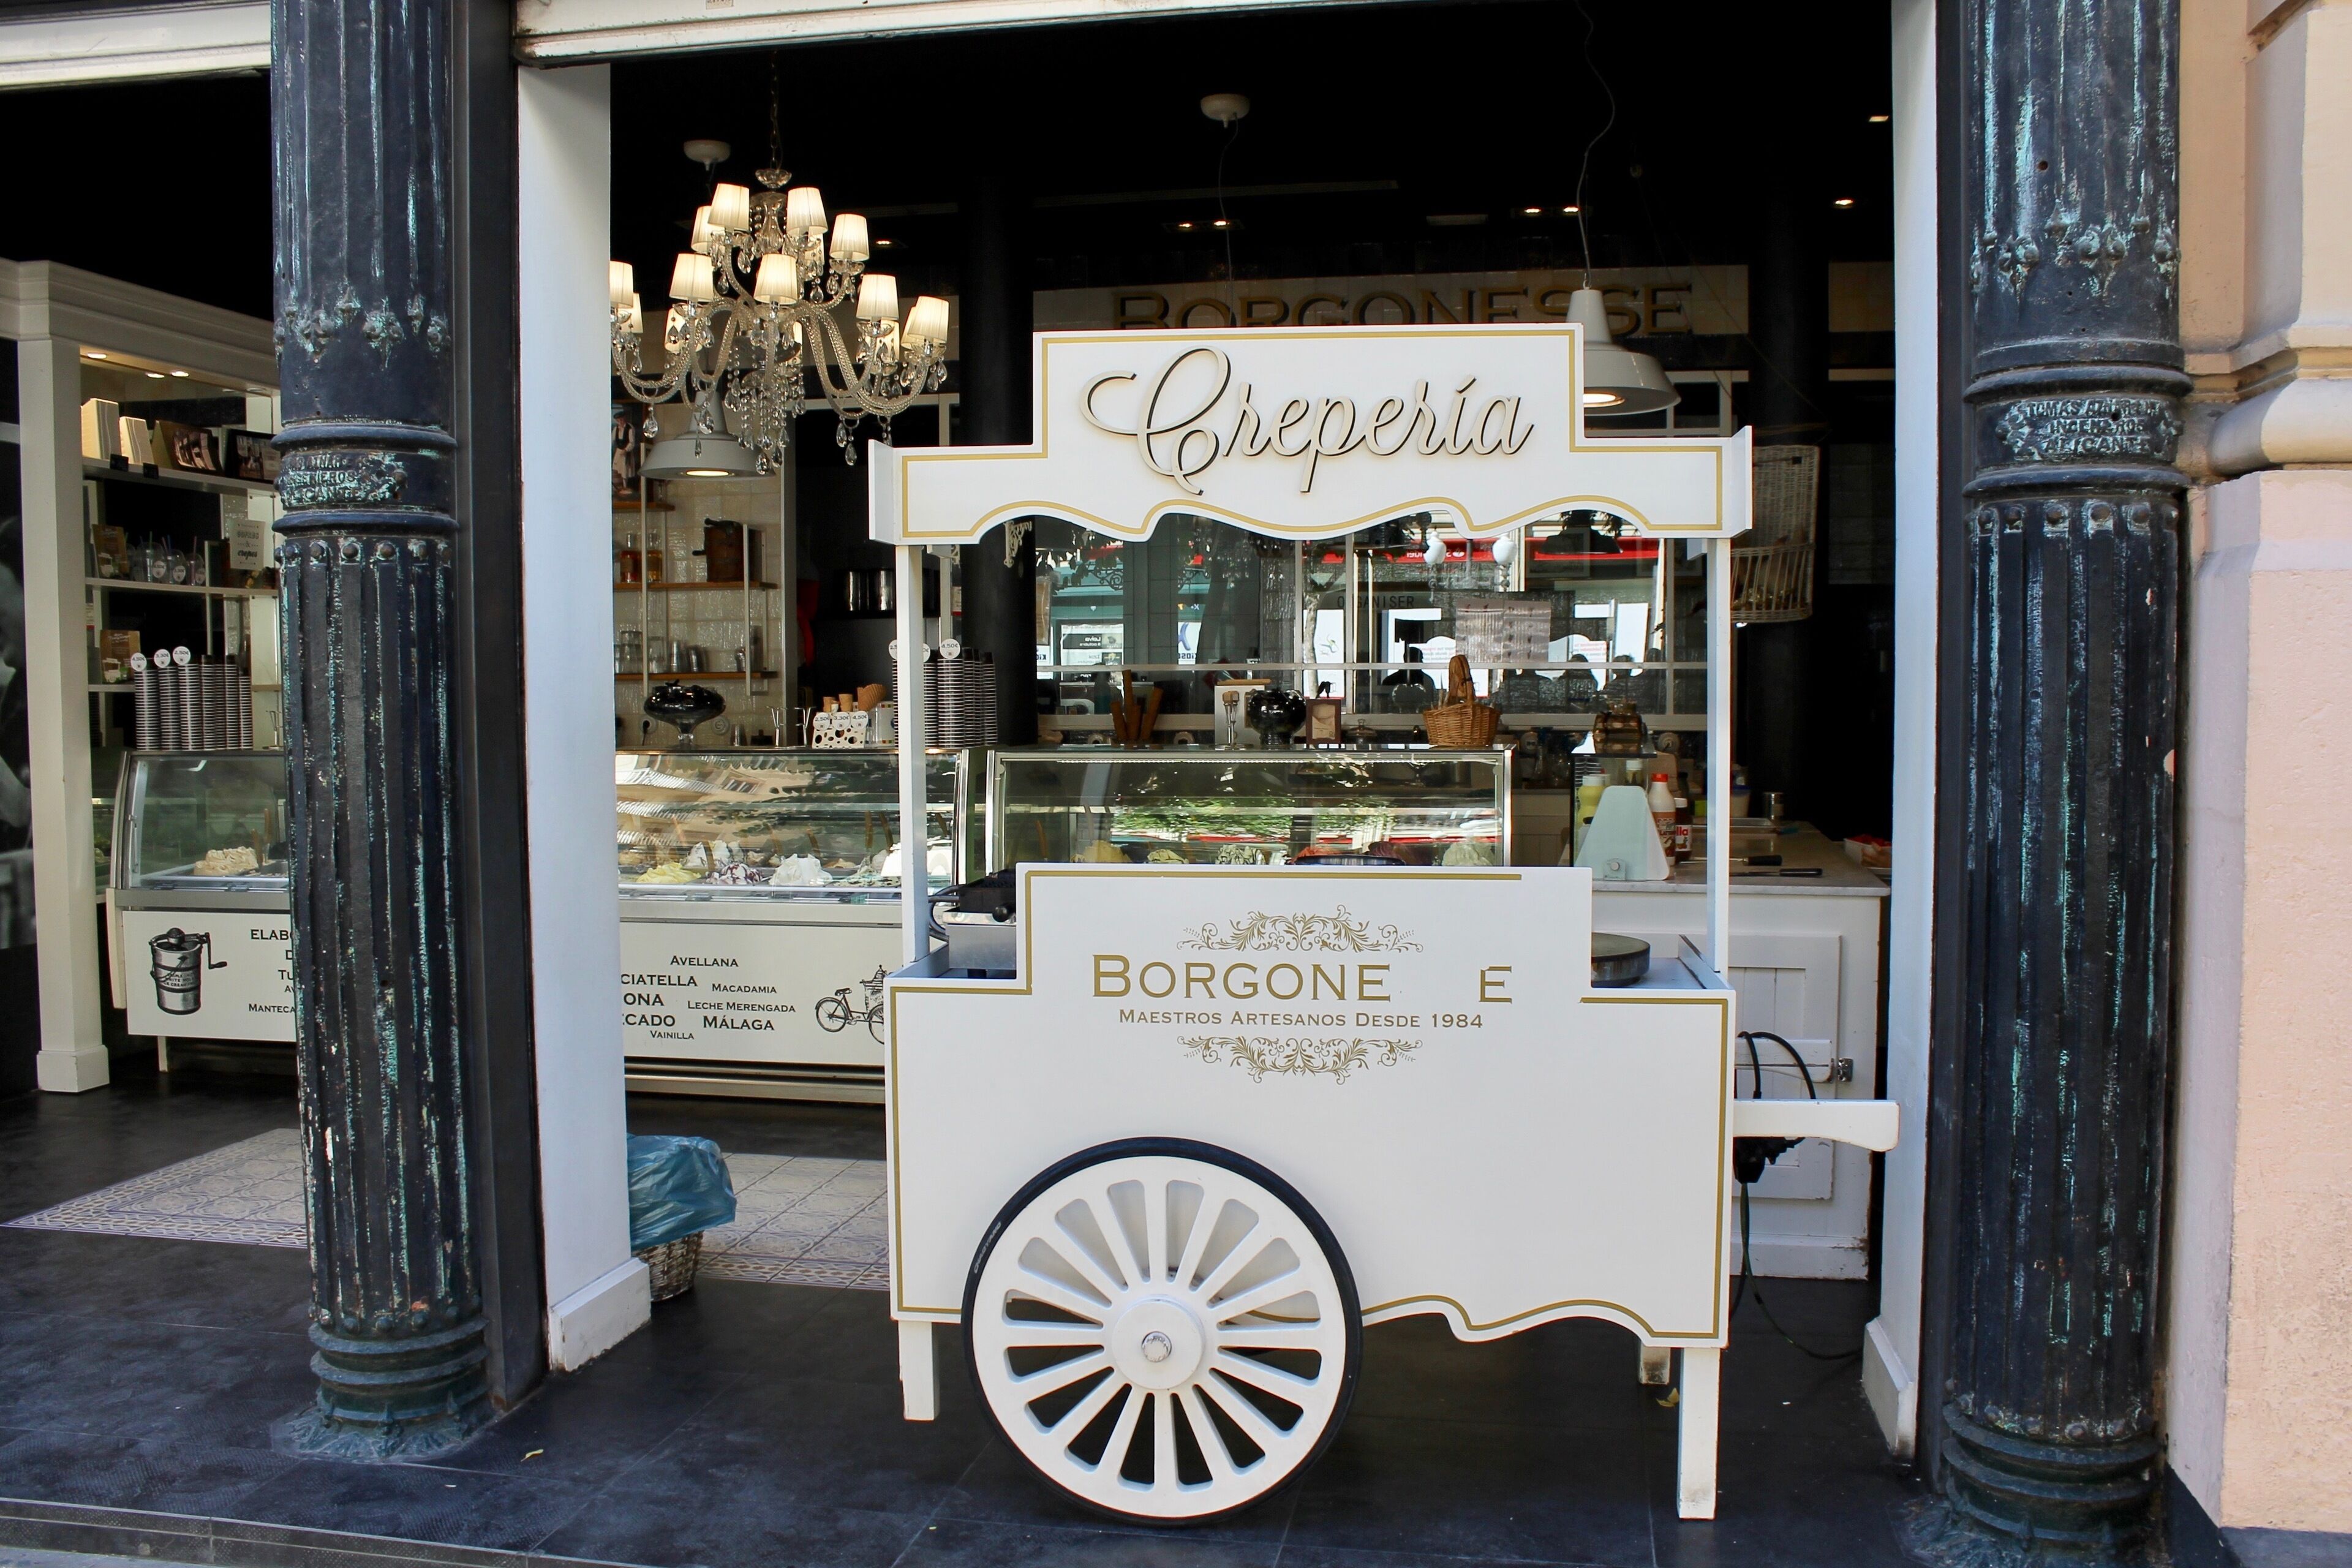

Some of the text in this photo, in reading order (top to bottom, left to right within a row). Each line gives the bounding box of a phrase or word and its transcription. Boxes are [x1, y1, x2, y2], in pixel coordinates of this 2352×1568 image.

[1080, 345, 1535, 496] Crepería
[250, 929, 293, 941] ELAB
[670, 956, 739, 967] AVELLANA
[712, 983, 777, 993] MACADAMIA
[687, 1001, 796, 1012] LECHE MERENGADA
[622, 1014, 676, 1027] CADO
[703, 1015, 775, 1031] MÁLAGA
[1119, 1009, 1483, 1029] MAESTROS ARTESANOS DESDE 1984
[650, 1030, 694, 1040] VAINILLA
